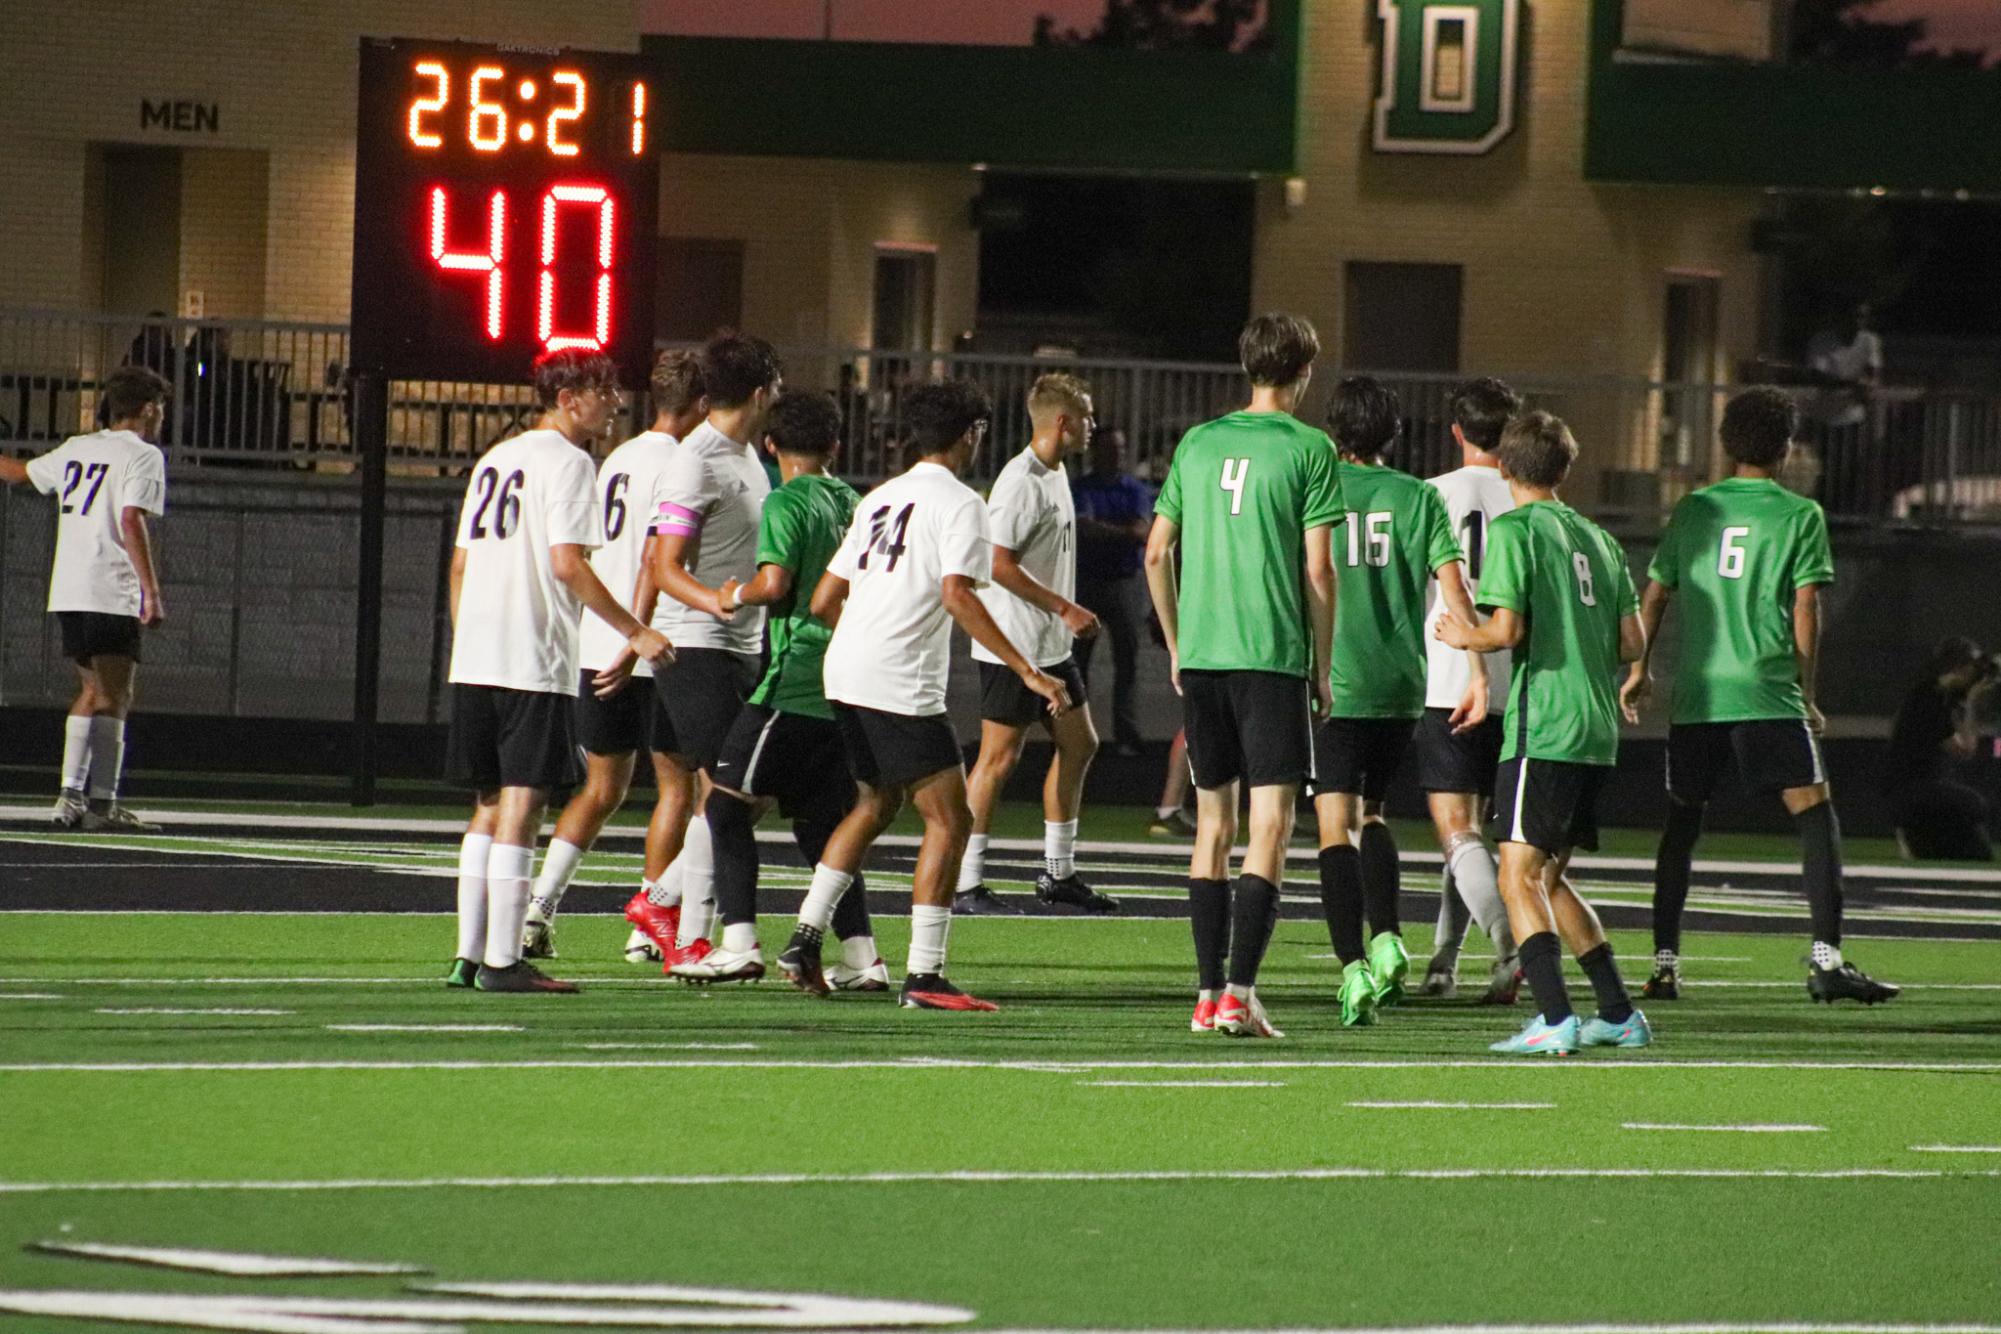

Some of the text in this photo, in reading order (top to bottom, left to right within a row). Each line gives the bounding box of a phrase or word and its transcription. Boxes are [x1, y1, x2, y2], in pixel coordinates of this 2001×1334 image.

[141, 100, 218, 132] MEN
[62, 460, 110, 516] 27
[470, 466, 525, 540] 26
[605, 472, 630, 541] 6
[1219, 457, 1251, 516] 4
[1345, 511, 1392, 568] 16
[1717, 526, 1750, 580] 6
[1572, 551, 1597, 607] 8
